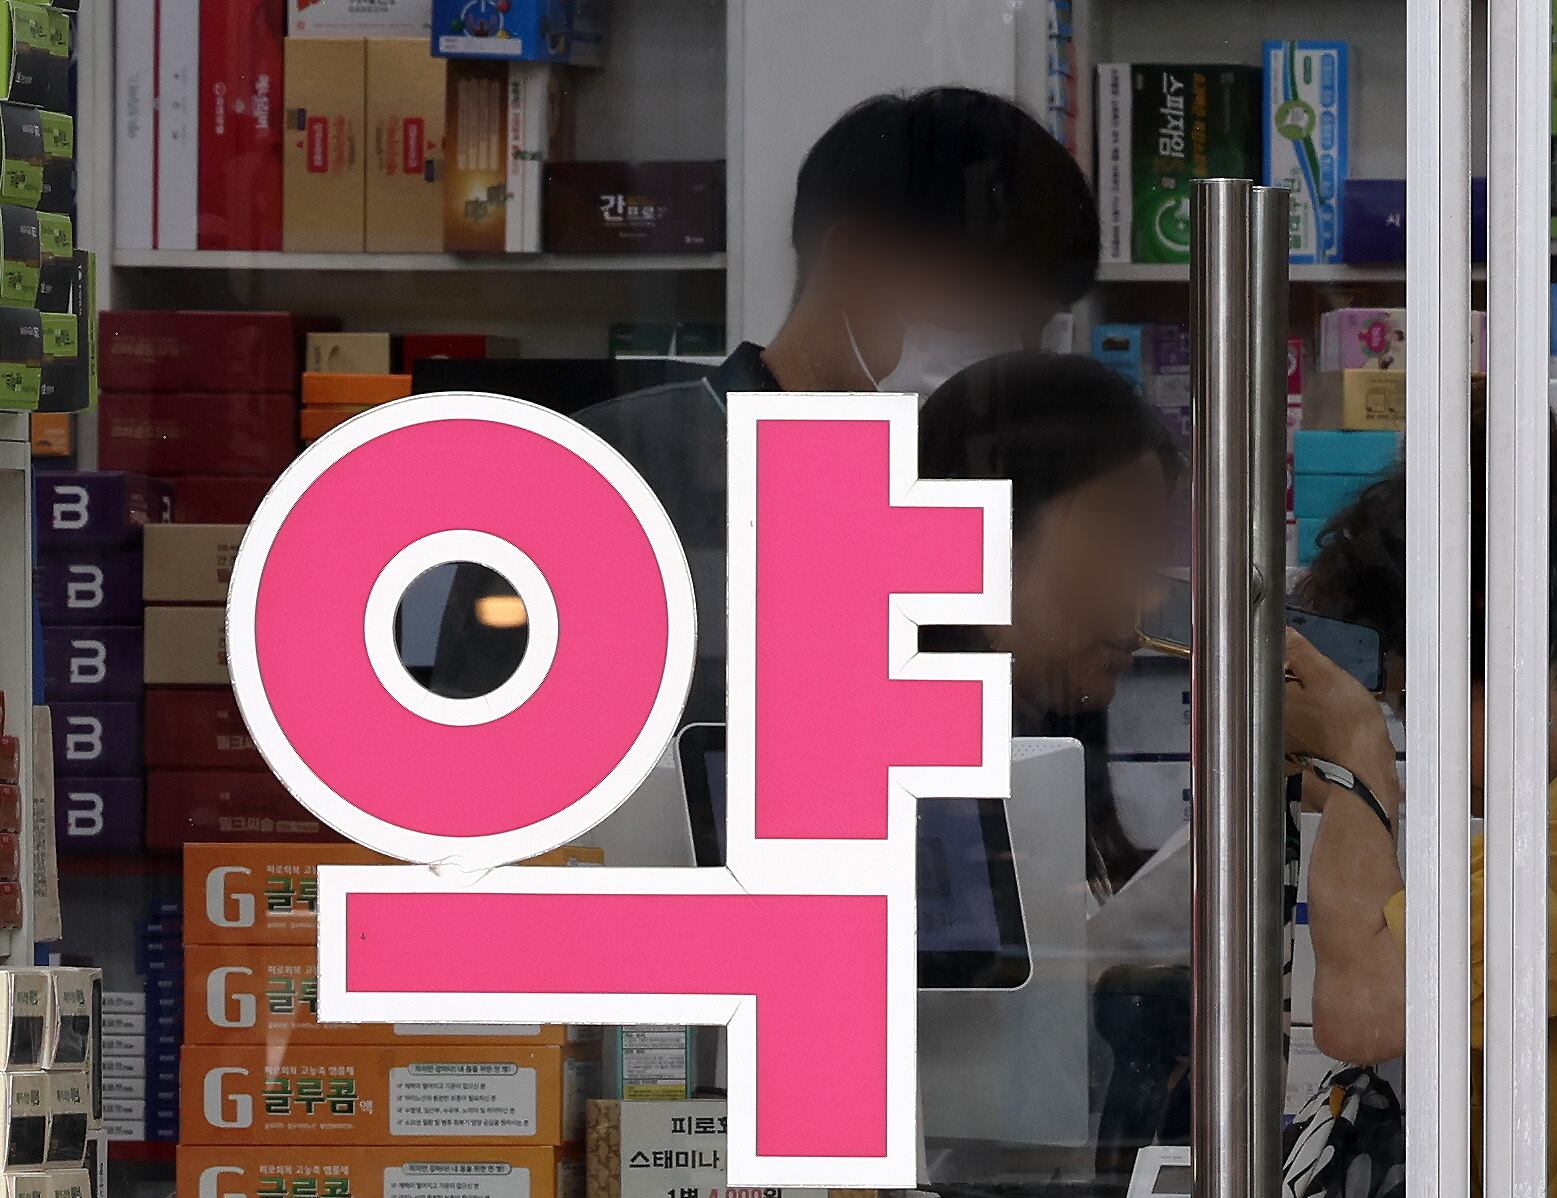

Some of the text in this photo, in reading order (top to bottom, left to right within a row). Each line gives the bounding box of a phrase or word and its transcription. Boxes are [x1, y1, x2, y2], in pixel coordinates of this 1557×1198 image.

[240, 405, 1000, 1172] 약
[206, 866, 256, 928] G
[207, 966, 257, 1028] G
[203, 1066, 253, 1128] G
[261, 1078, 359, 1116] 글루콤
[629, 1150, 720, 1169] 스태미나
